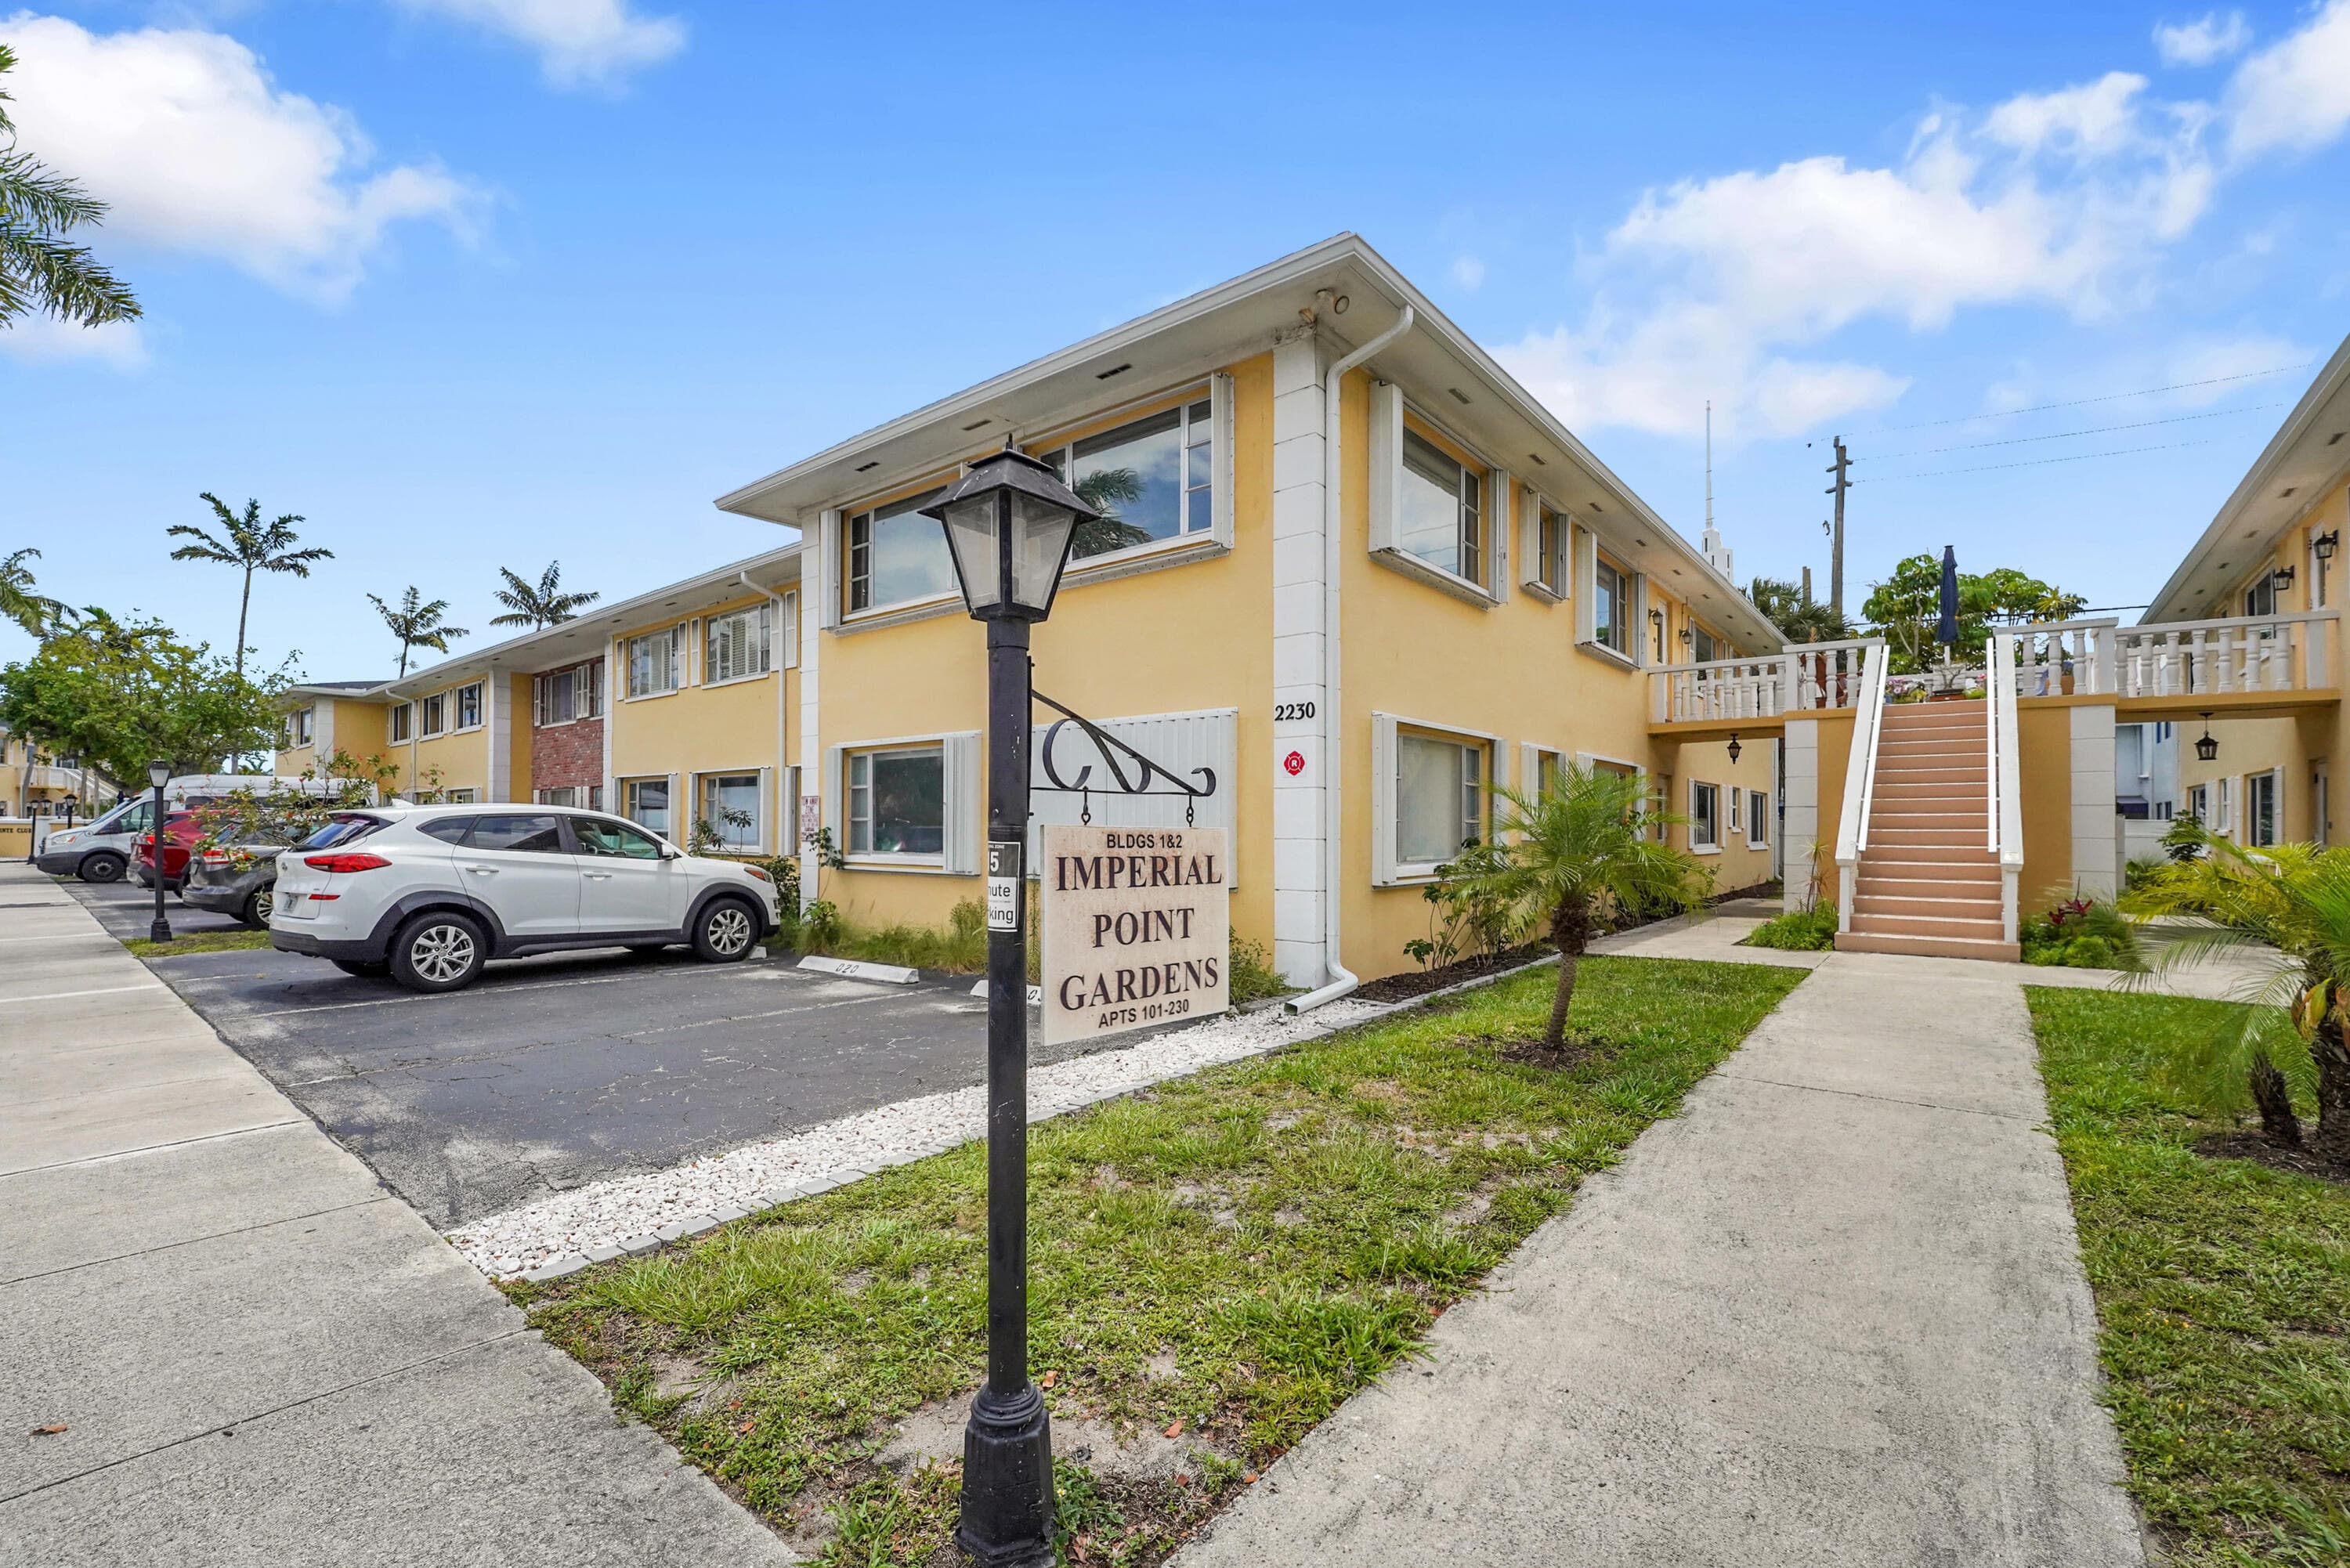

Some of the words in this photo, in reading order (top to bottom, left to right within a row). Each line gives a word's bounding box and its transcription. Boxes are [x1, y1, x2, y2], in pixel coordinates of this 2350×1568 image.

[1274, 702, 1315, 721] 2230
[1107, 834, 1155, 848] BLDGS
[1159, 834, 1183, 848] 1&2
[1055, 854, 1223, 891] IMPERIAL
[1092, 908, 1195, 948] POINT
[836, 963, 859, 974] 020
[1060, 957, 1218, 1010] GARDENS
[1098, 1008, 1137, 1028] APTS
[1141, 999, 1189, 1020] 101-230
